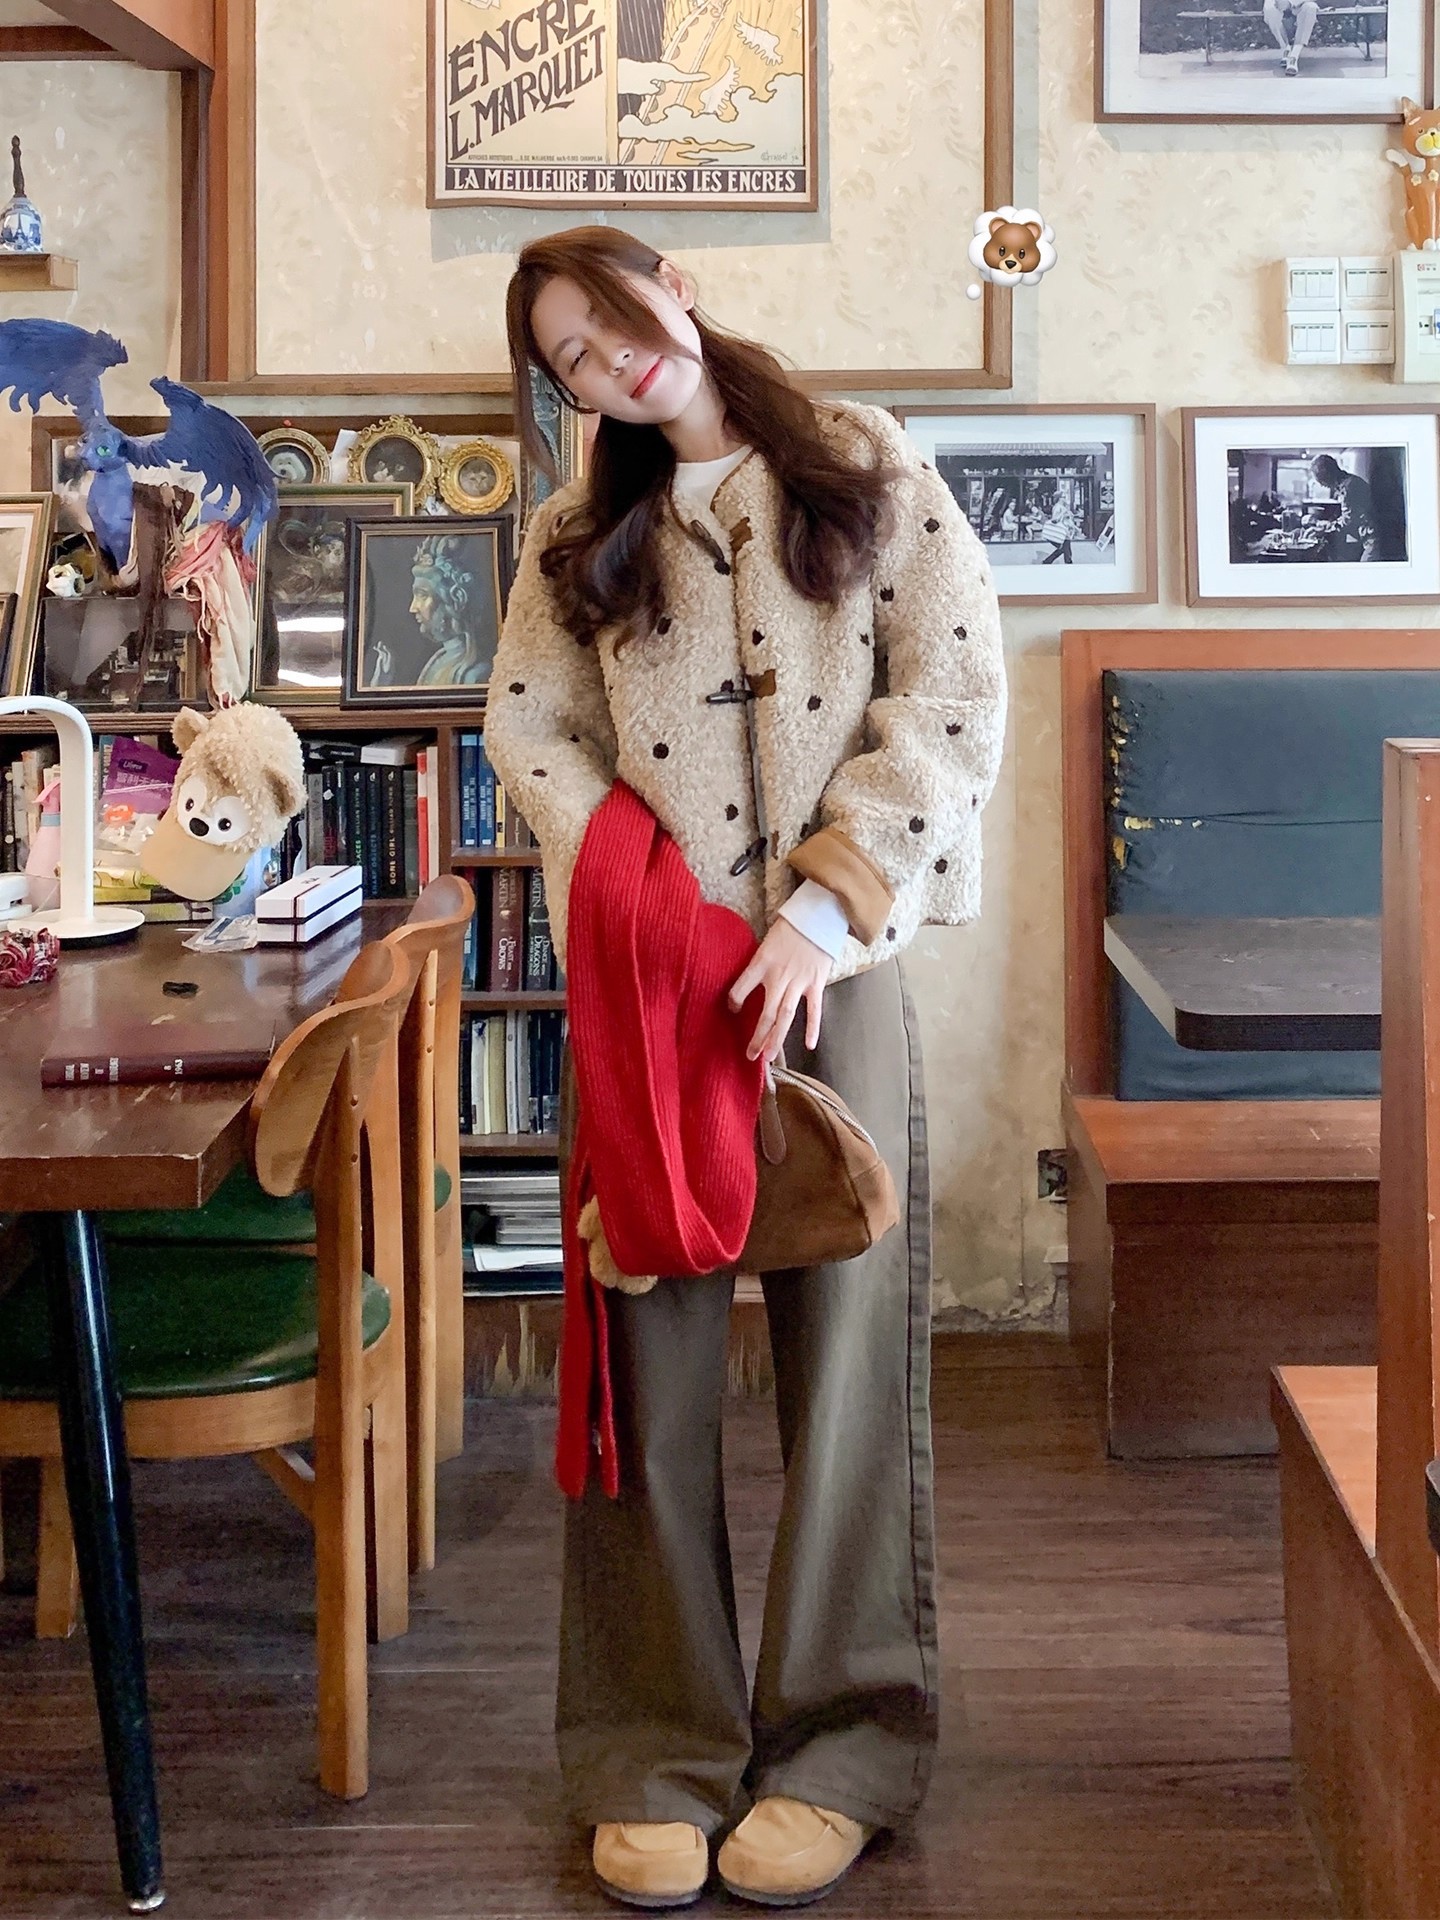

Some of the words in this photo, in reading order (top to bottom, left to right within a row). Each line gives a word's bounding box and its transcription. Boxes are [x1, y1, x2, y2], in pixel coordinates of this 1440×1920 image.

[448, 0, 595, 106] ENCRE
[453, 168, 480, 190] LA
[484, 169, 588, 191] MEILLEURE
[595, 169, 616, 192] DE
[623, 169, 686, 192] TOUTES
[692, 170, 722, 192] LES
[727, 170, 796, 193] ENCRES
[499, 866, 509, 908] MARTIN
[532, 866, 543, 908] MARTIN
[498, 937, 508, 970] CROWS
[507, 940, 516, 962] FEAST
[532, 935, 543, 977] DRAGONS
[541, 940, 550, 963] DANCE
